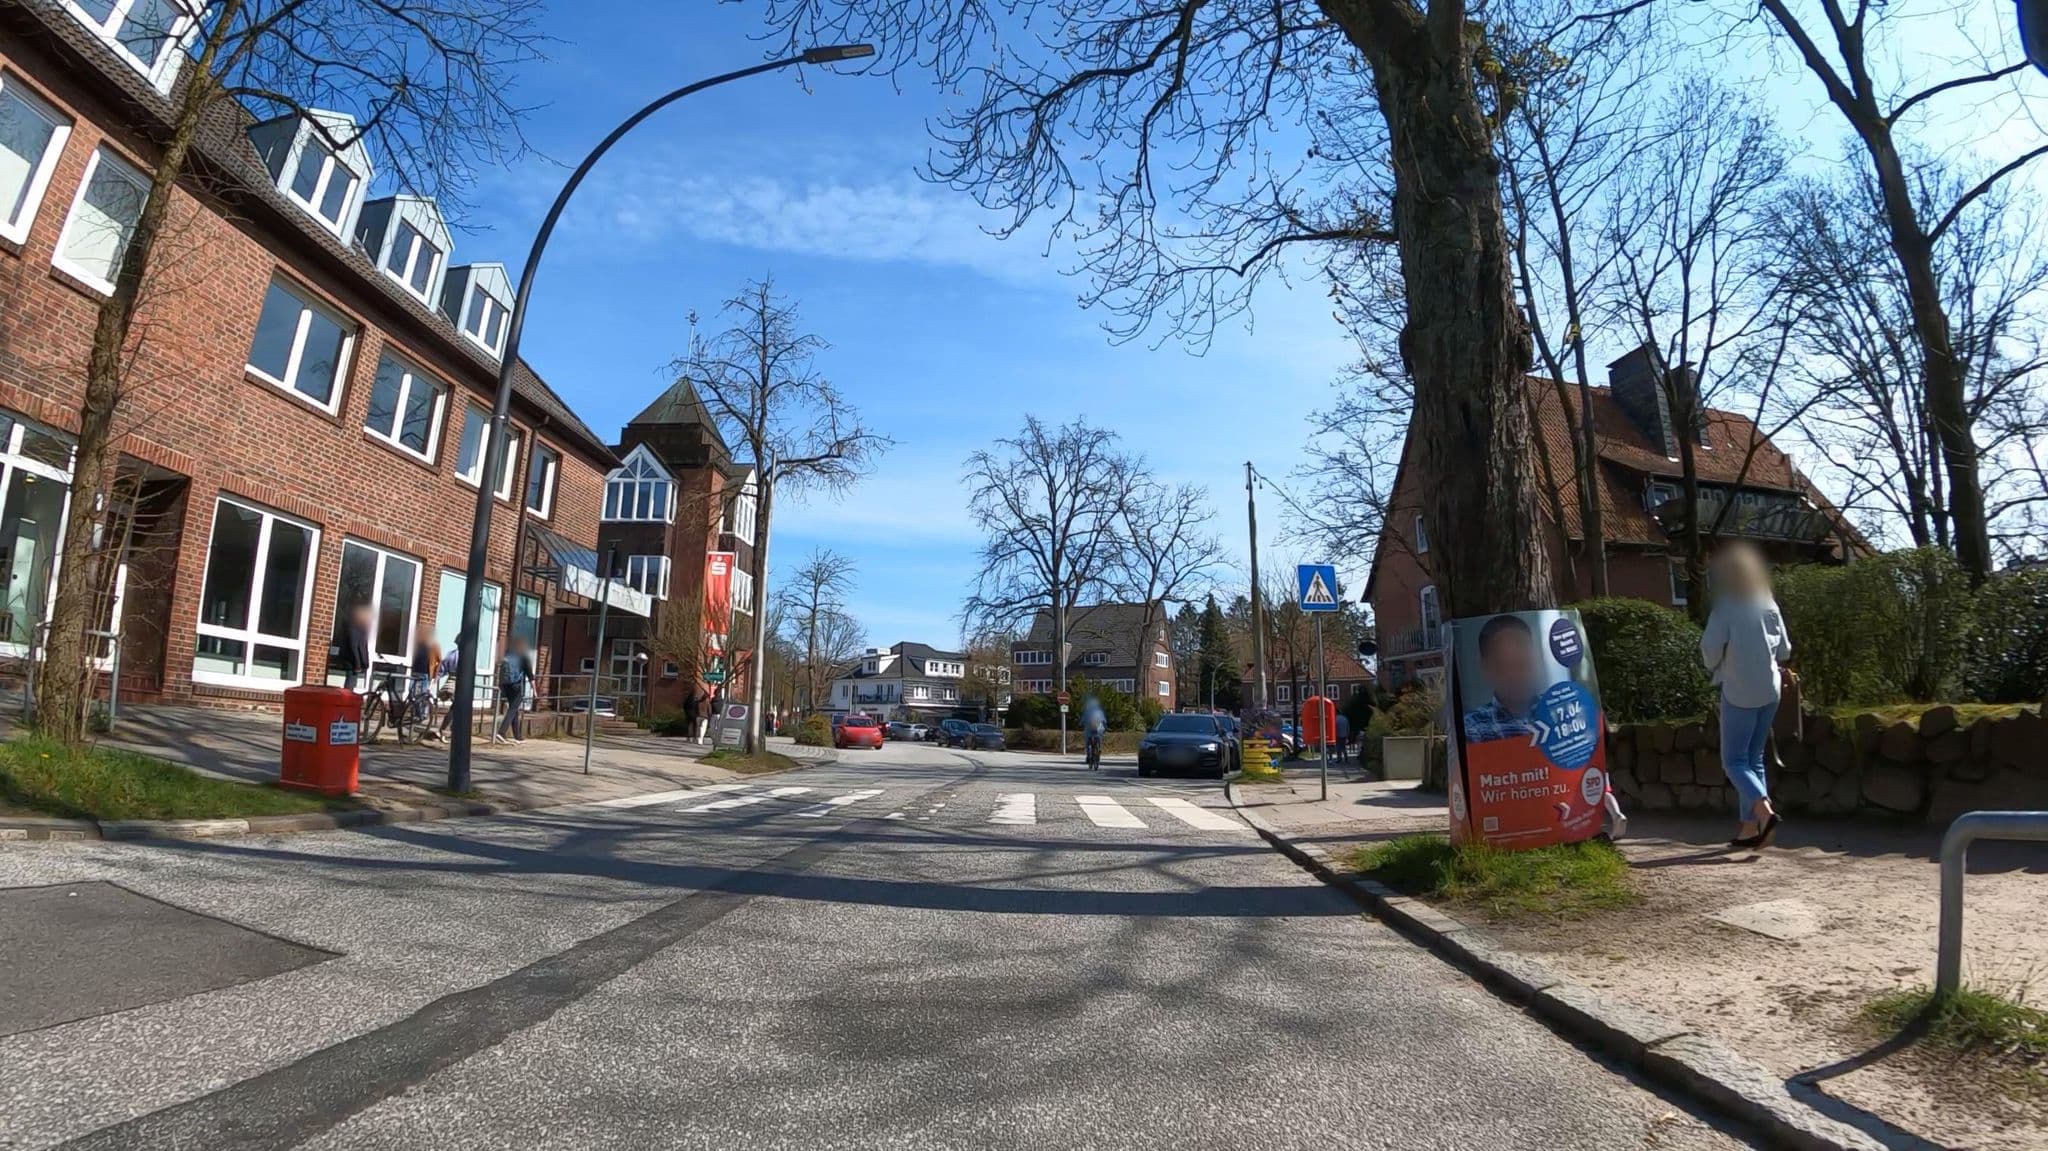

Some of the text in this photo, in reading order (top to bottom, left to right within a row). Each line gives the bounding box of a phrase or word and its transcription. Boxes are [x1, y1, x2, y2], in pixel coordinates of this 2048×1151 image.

[1480, 767, 1549, 788] Mach mit!
[1585, 775, 1601, 789] SPD
[1480, 788, 1507, 804] Wir
[1511, 785, 1550, 801] hören
[1553, 783, 1570, 795] zu.
